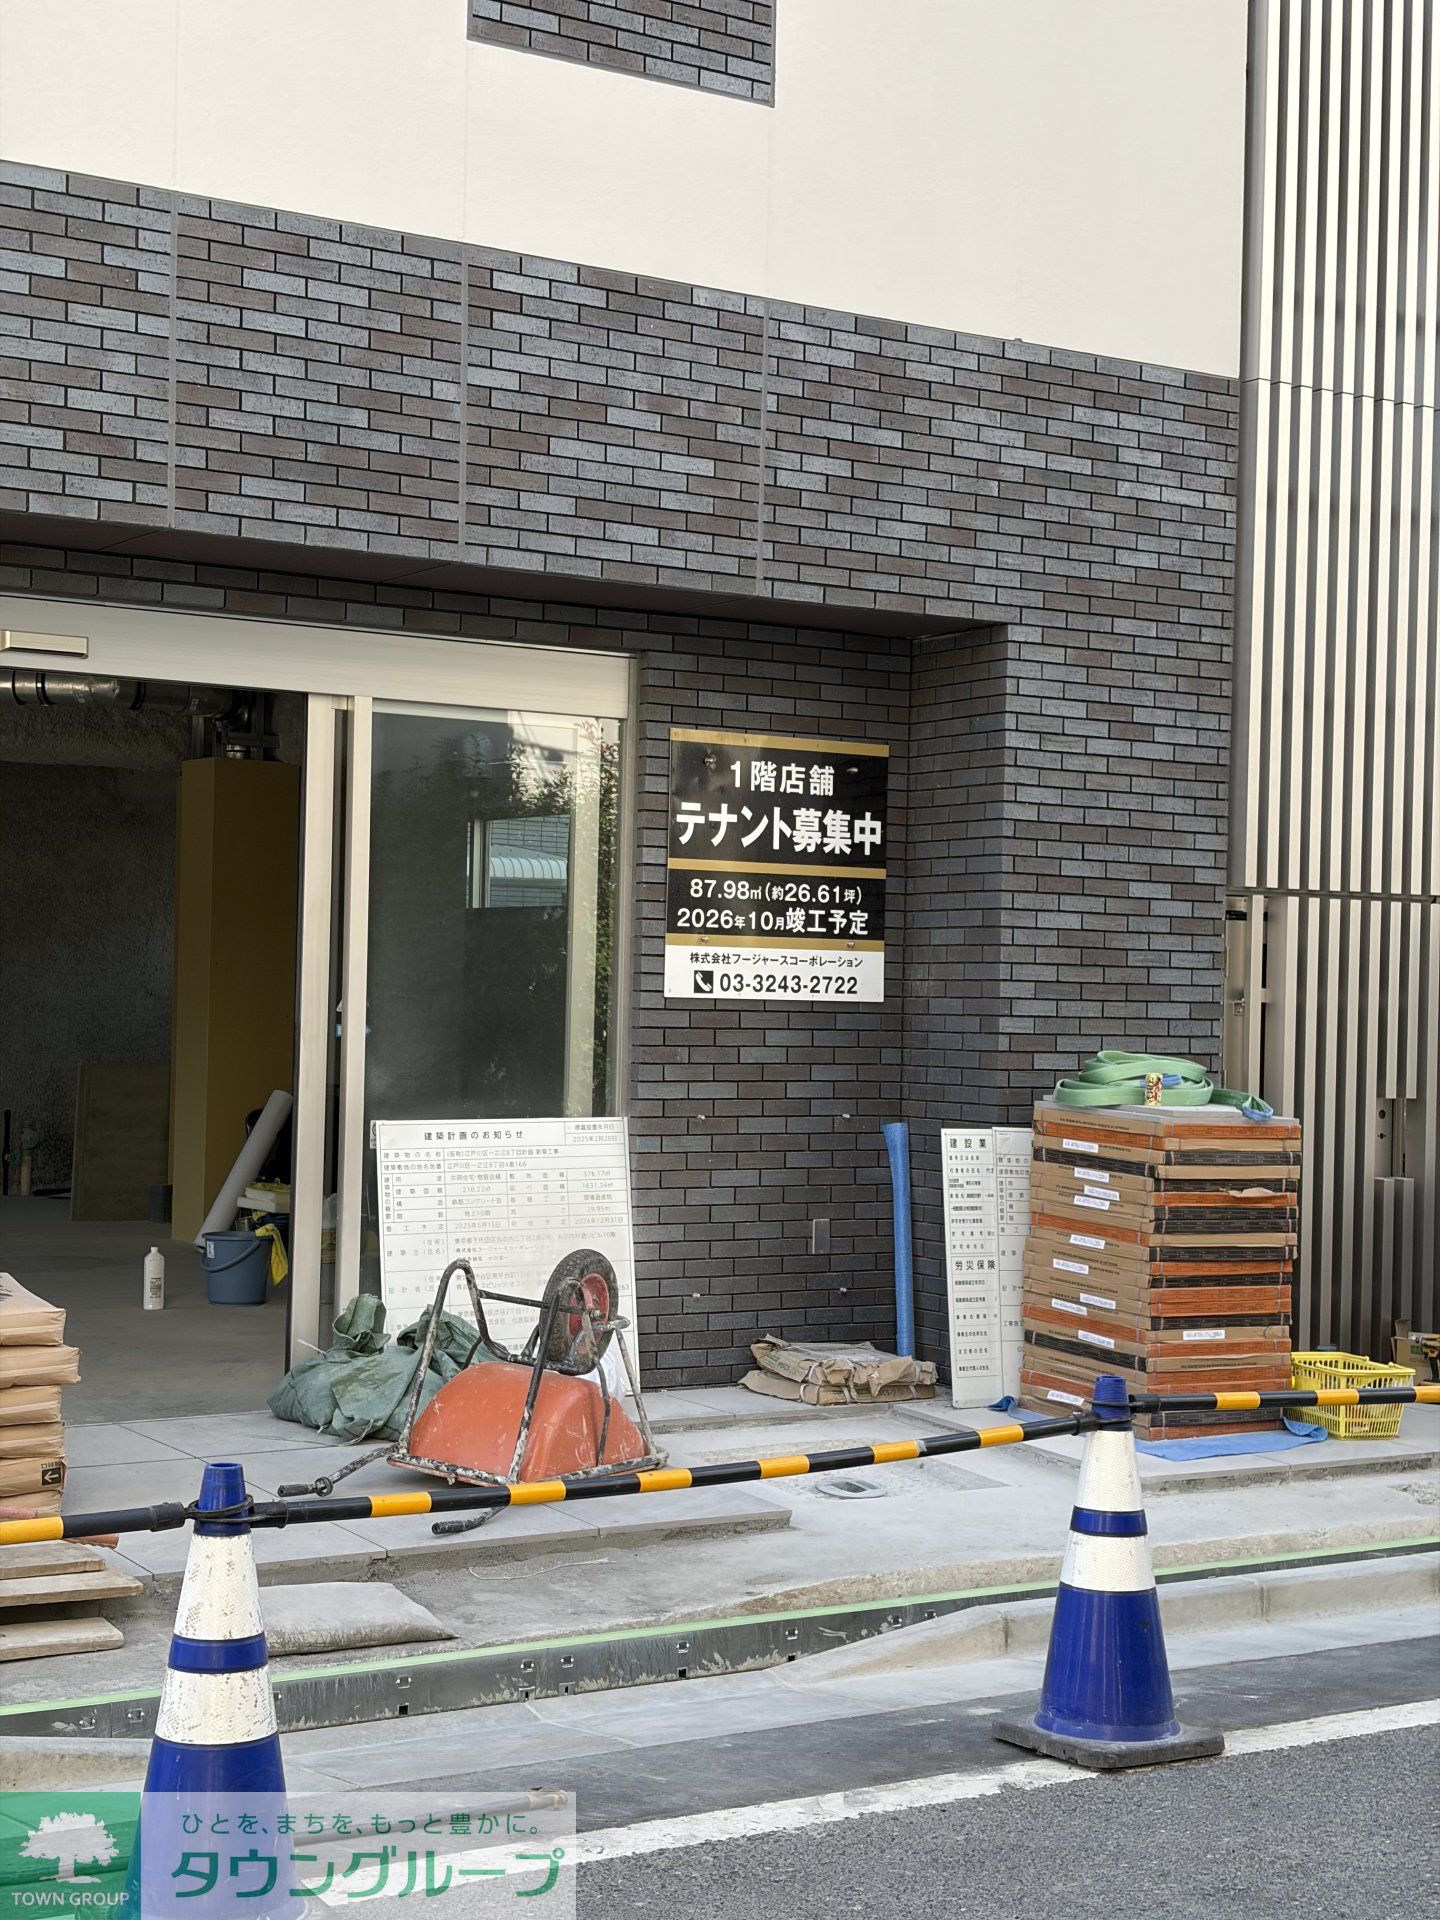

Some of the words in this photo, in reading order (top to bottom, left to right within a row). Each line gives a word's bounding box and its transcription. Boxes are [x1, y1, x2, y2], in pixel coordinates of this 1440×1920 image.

[730, 760, 836, 796] 1階店舗
[676, 801, 882, 856] テナント募集中
[677, 907, 869, 935] 2026年10月竣工予定
[690, 952, 863, 968] 株式会社フージャースコーポレーション
[719, 973, 858, 994] 03-3243-2722
[424, 1130, 523, 1141] 建築計画のお知らせ
[573, 1135, 618, 1143] 2025年2月20日
[955, 1259, 996, 1271] 労災保険
